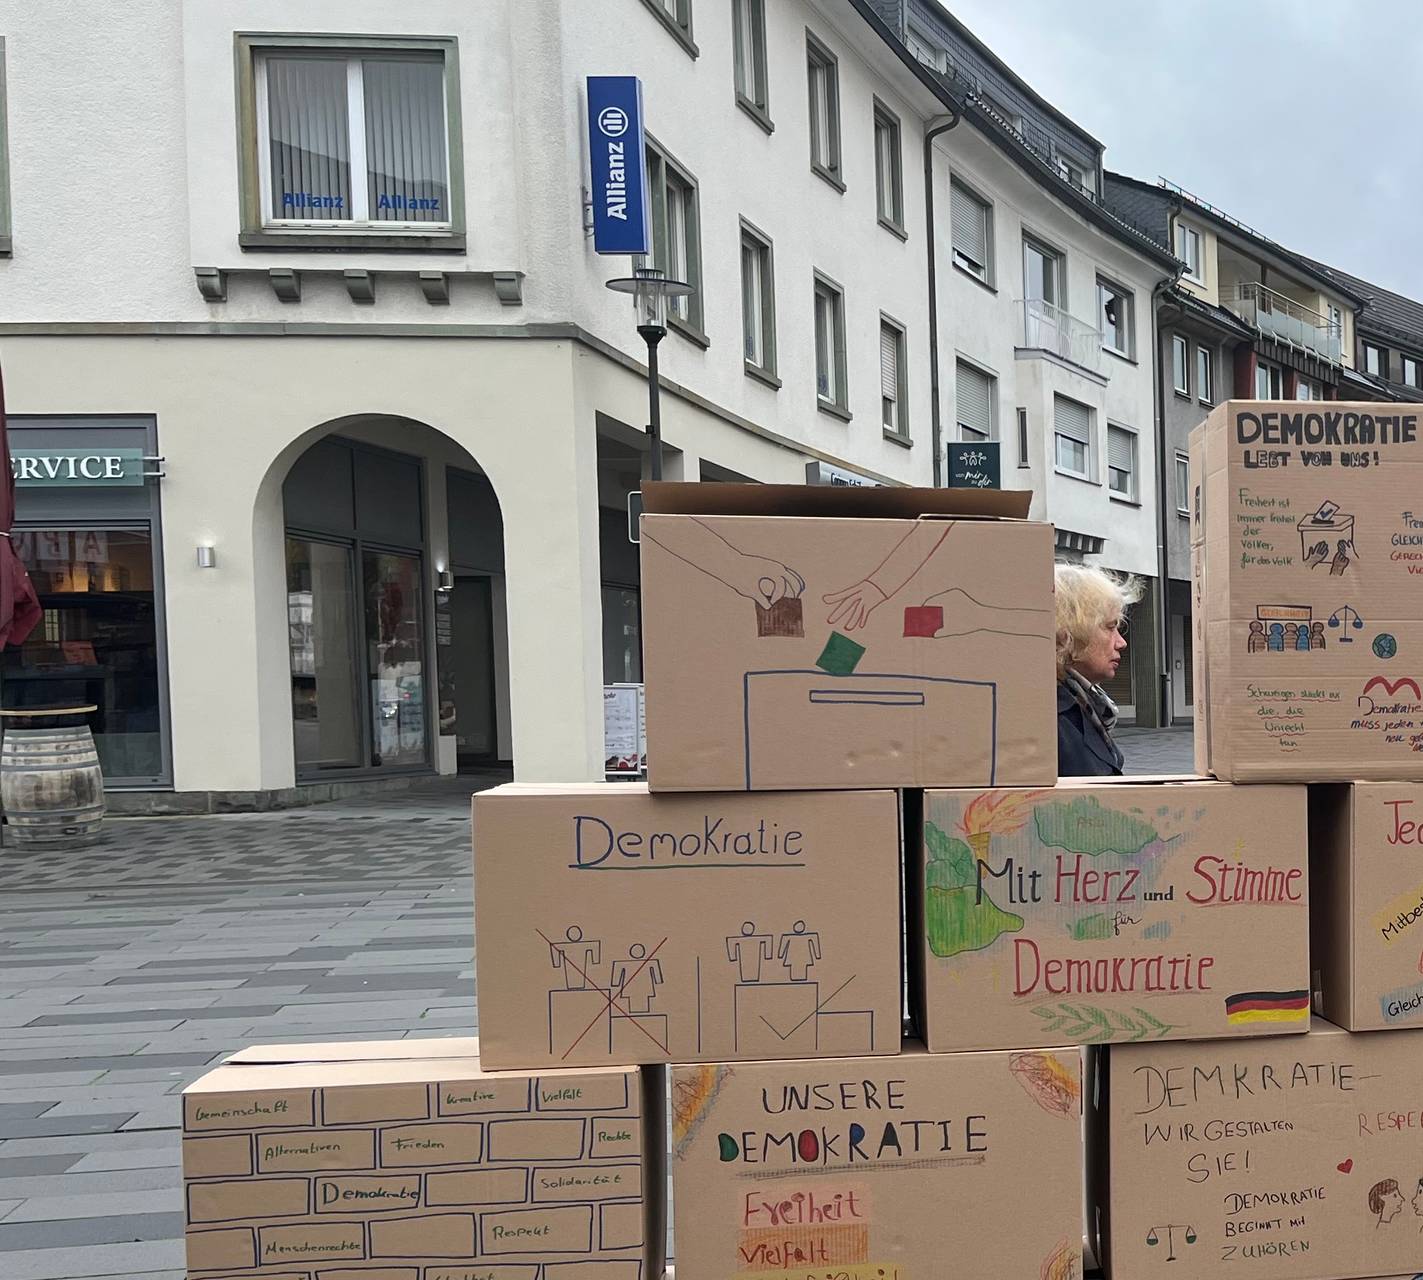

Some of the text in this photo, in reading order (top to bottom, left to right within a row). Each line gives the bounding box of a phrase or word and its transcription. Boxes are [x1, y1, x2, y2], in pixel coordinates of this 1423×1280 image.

[606, 142, 628, 220] Allianz
[282, 193, 343, 209] Allianz
[379, 194, 439, 210] Allianz
[1237, 412, 1417, 446] DEMOKRATIE
[1244, 451, 1291, 468] LEBT
[1301, 451, 1333, 467] VON
[1350, 719, 1381, 730] muss
[1382, 719, 1414, 732] jeden
[573, 816, 802, 867] Demokratie
[975, 854, 1303, 905] Mit Herz und Stimme
[1111, 911, 1142, 935] für
[1013, 938, 1215, 998] Demokratie
[195, 1102, 289, 1123] Gemeinschaft
[542, 1089, 583, 1104] Vielfalt
[762, 1079, 906, 1114] UNSERE
[264, 1130, 632, 1161] Alternativen Frieden Rechte
[718, 1115, 988, 1165] DEMOKRATIE
[1204, 1119, 1295, 1142] GESTALTEN
[322, 1174, 623, 1206] Demokratie Solidarität
[1224, 1186, 1327, 1215] DEMOKRATIE
[743, 1190, 863, 1228] Freiheit
[265, 1224, 551, 1257] Menschenrechte Respekt
[1225, 1219, 1282, 1238] BEGINNT
[1221, 1240, 1310, 1261] ZUHÖREN
